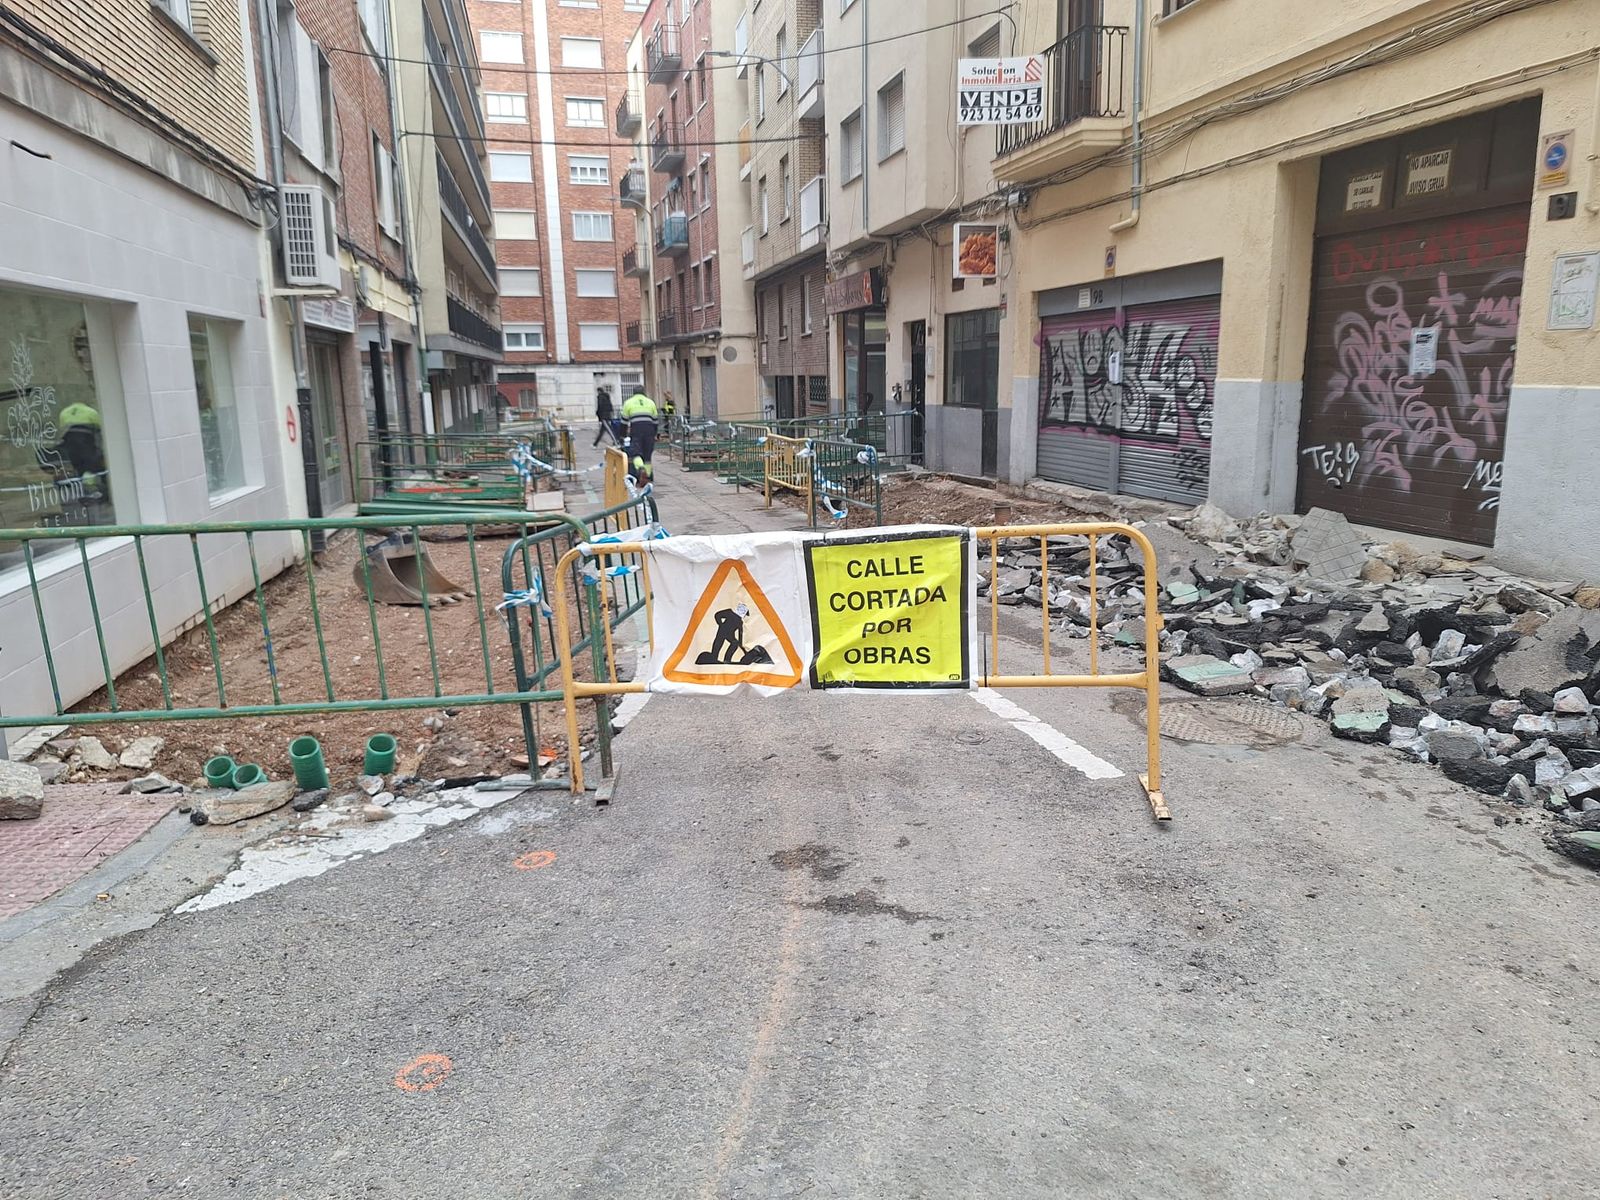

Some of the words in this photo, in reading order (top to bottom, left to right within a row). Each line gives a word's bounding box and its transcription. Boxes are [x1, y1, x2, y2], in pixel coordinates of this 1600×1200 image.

[963, 89, 1038, 108] VENDE
[960, 107, 984, 121] 923
[987, 107, 1001, 121] 12
[1005, 106, 1022, 121] 54
[1025, 105, 1042, 119] 89
[28, 480, 85, 512] Bloom
[847, 555, 925, 578] CALLE
[829, 585, 947, 612] CORTADA
[861, 617, 912, 638] POR
[843, 646, 931, 664] OBRAS
